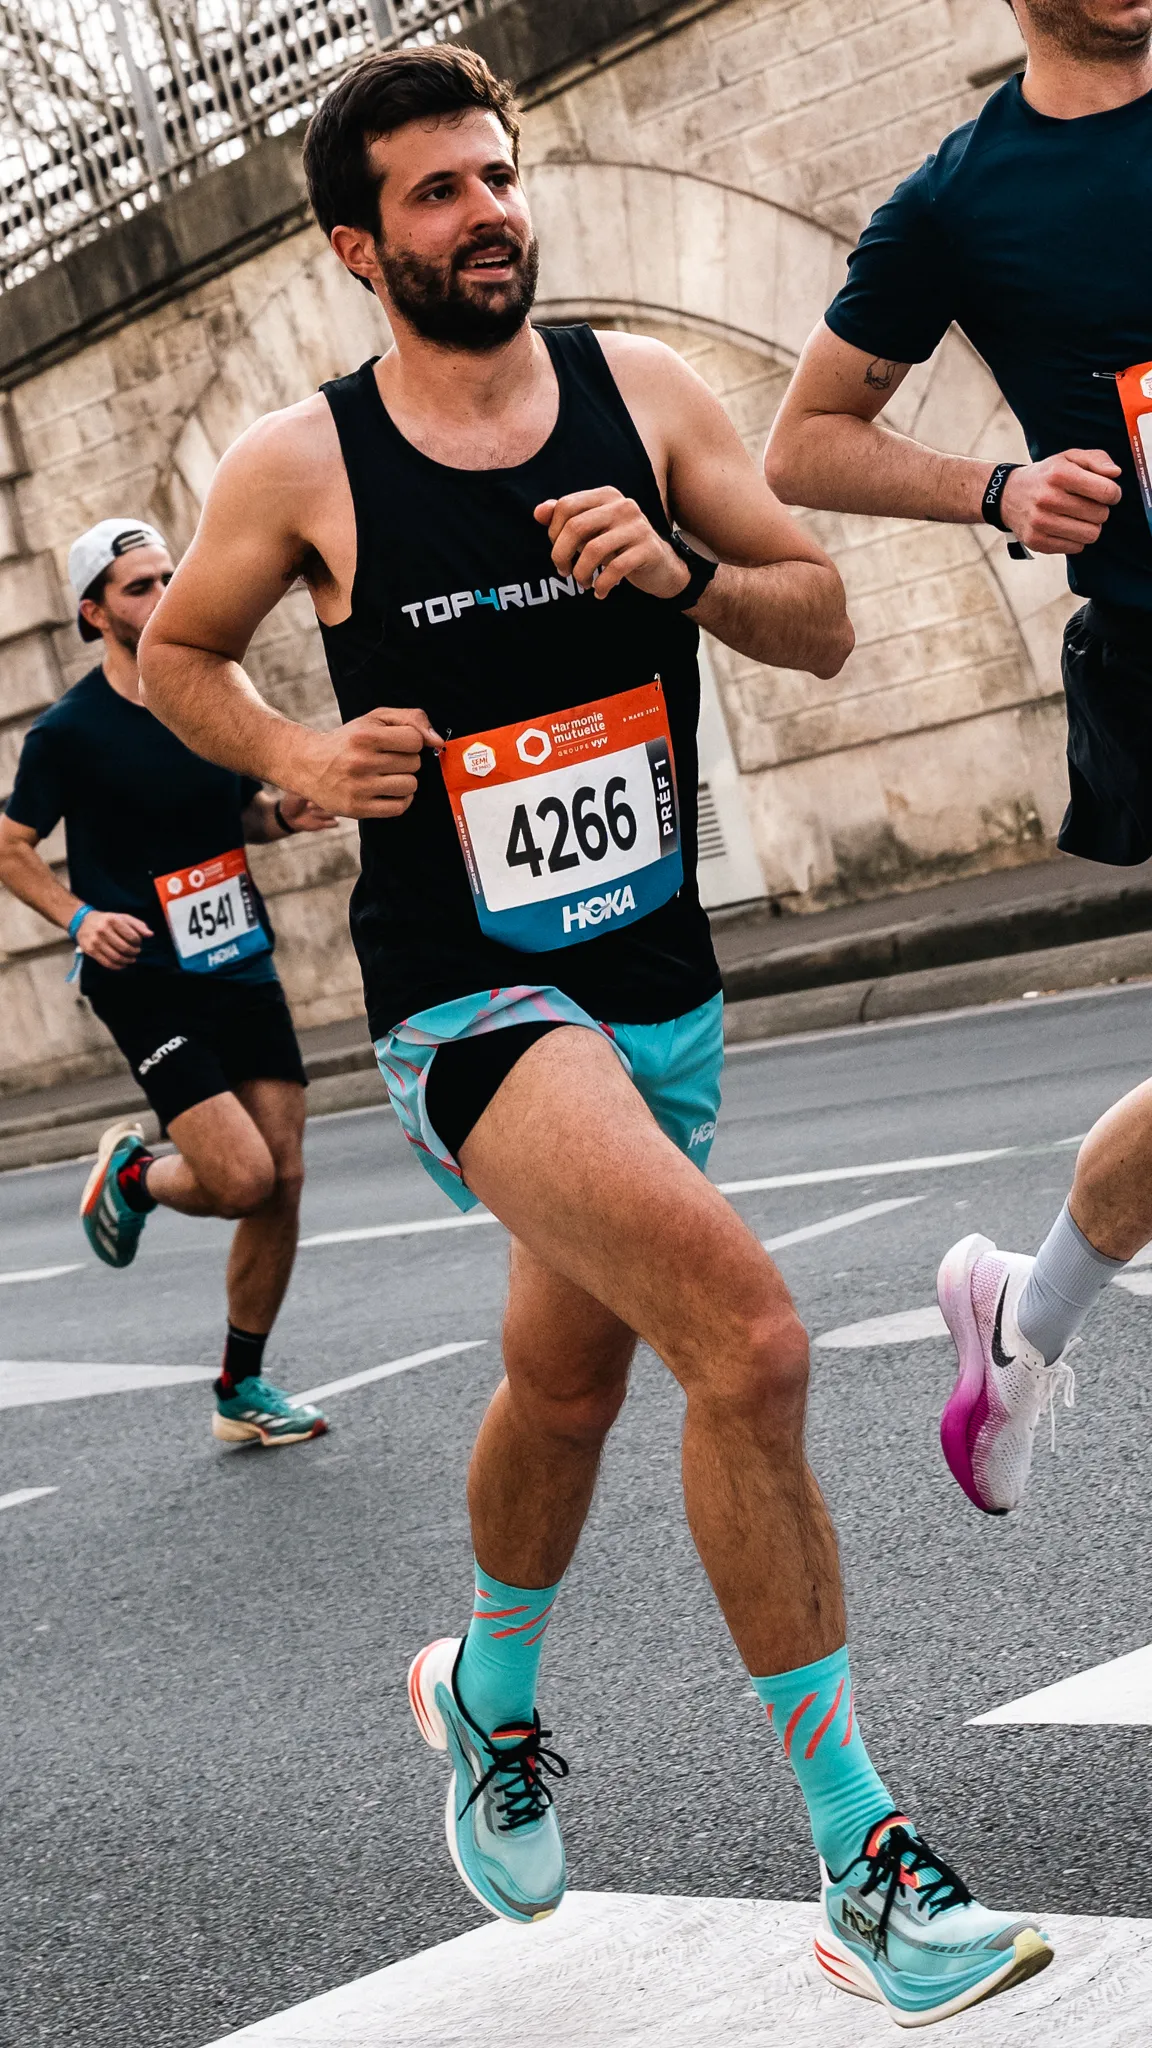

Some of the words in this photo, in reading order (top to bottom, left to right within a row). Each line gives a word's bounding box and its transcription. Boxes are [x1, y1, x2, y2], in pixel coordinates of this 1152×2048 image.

[986, 470, 1006, 503] PACK
[401, 565, 620, 628] TOP4RUN
[551, 712, 603, 734] Harmonie
[553, 722, 606, 744] mutuelle
[558, 743, 590, 757] GROUPE
[591, 737, 608, 748] vyv
[654, 759, 666, 771] 1
[656, 776, 674, 836] PRÉF
[505, 776, 637, 878] 4266
[188, 892, 235, 940] 4541
[562, 885, 637, 934] HOKA
